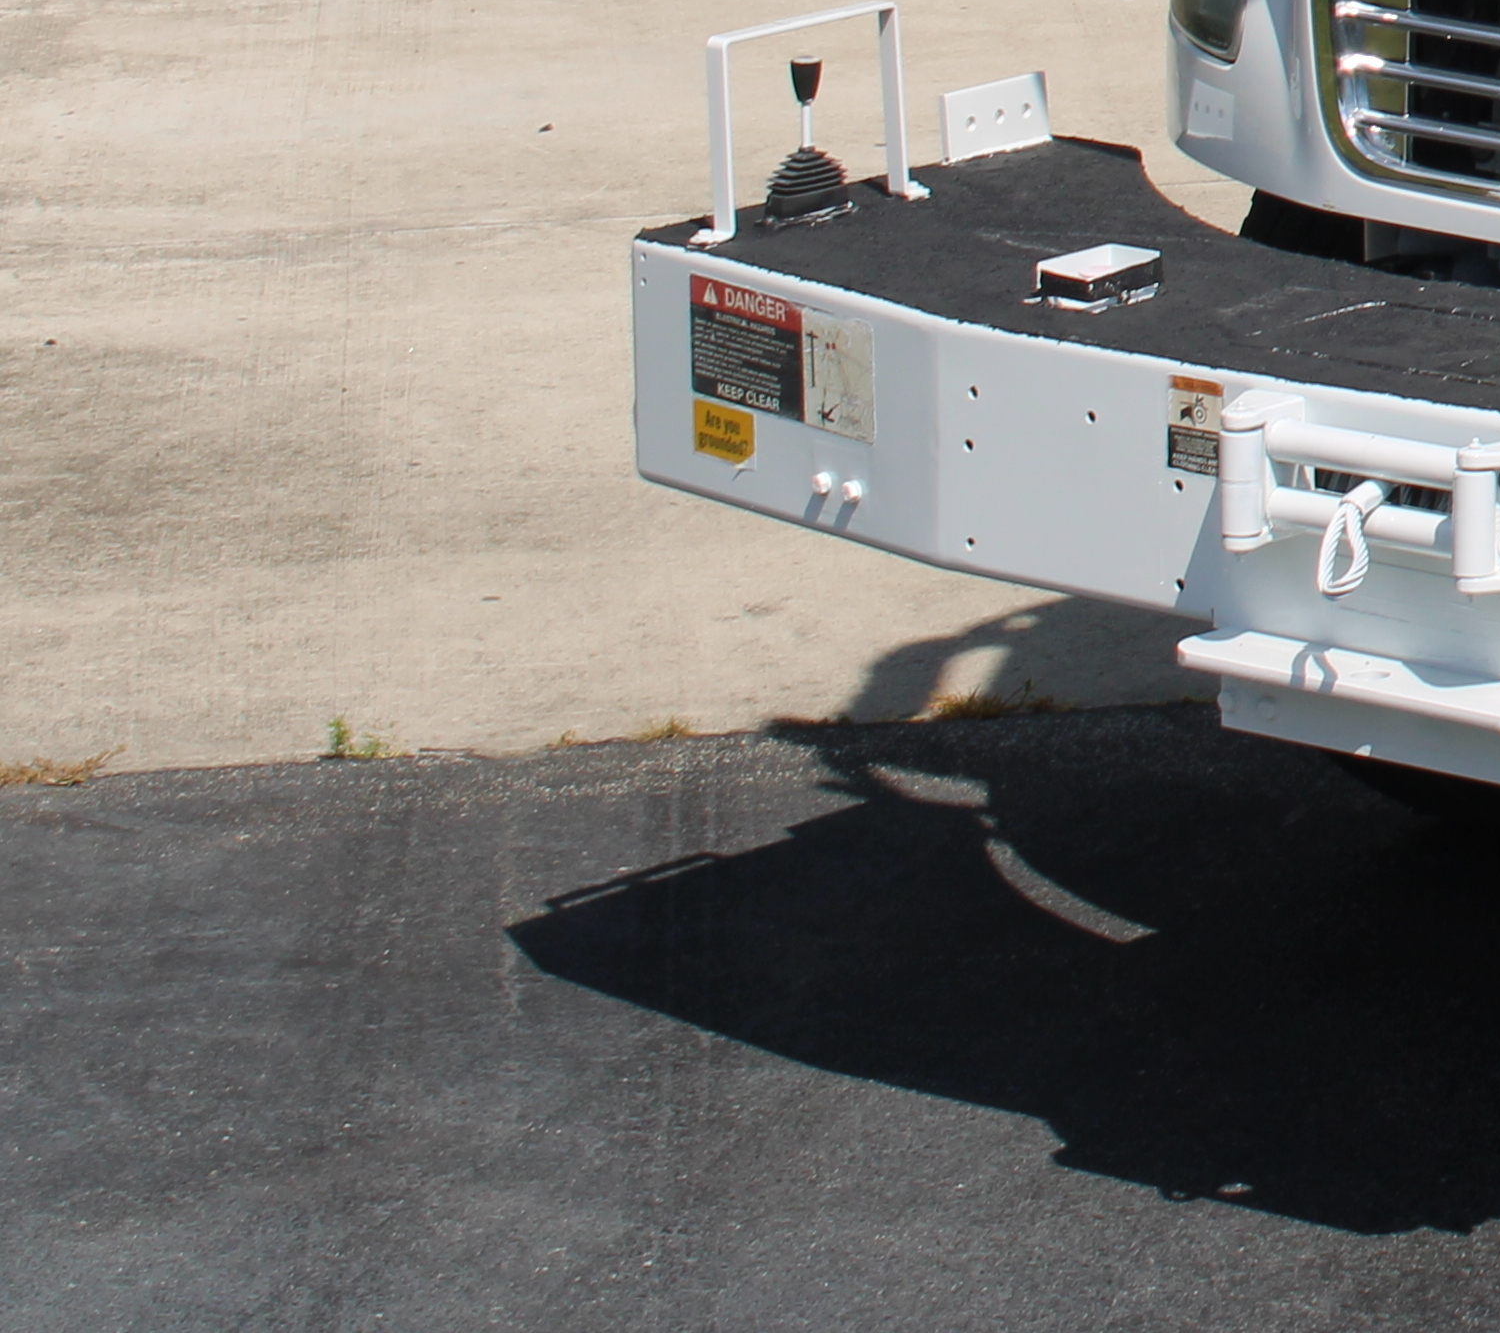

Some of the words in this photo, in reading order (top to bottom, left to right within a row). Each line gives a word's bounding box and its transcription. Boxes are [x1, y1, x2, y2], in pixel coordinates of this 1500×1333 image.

[724, 287, 786, 322] DANGER
[717, 382, 744, 401] KEEP
[745, 389, 780, 411] CLEAR
